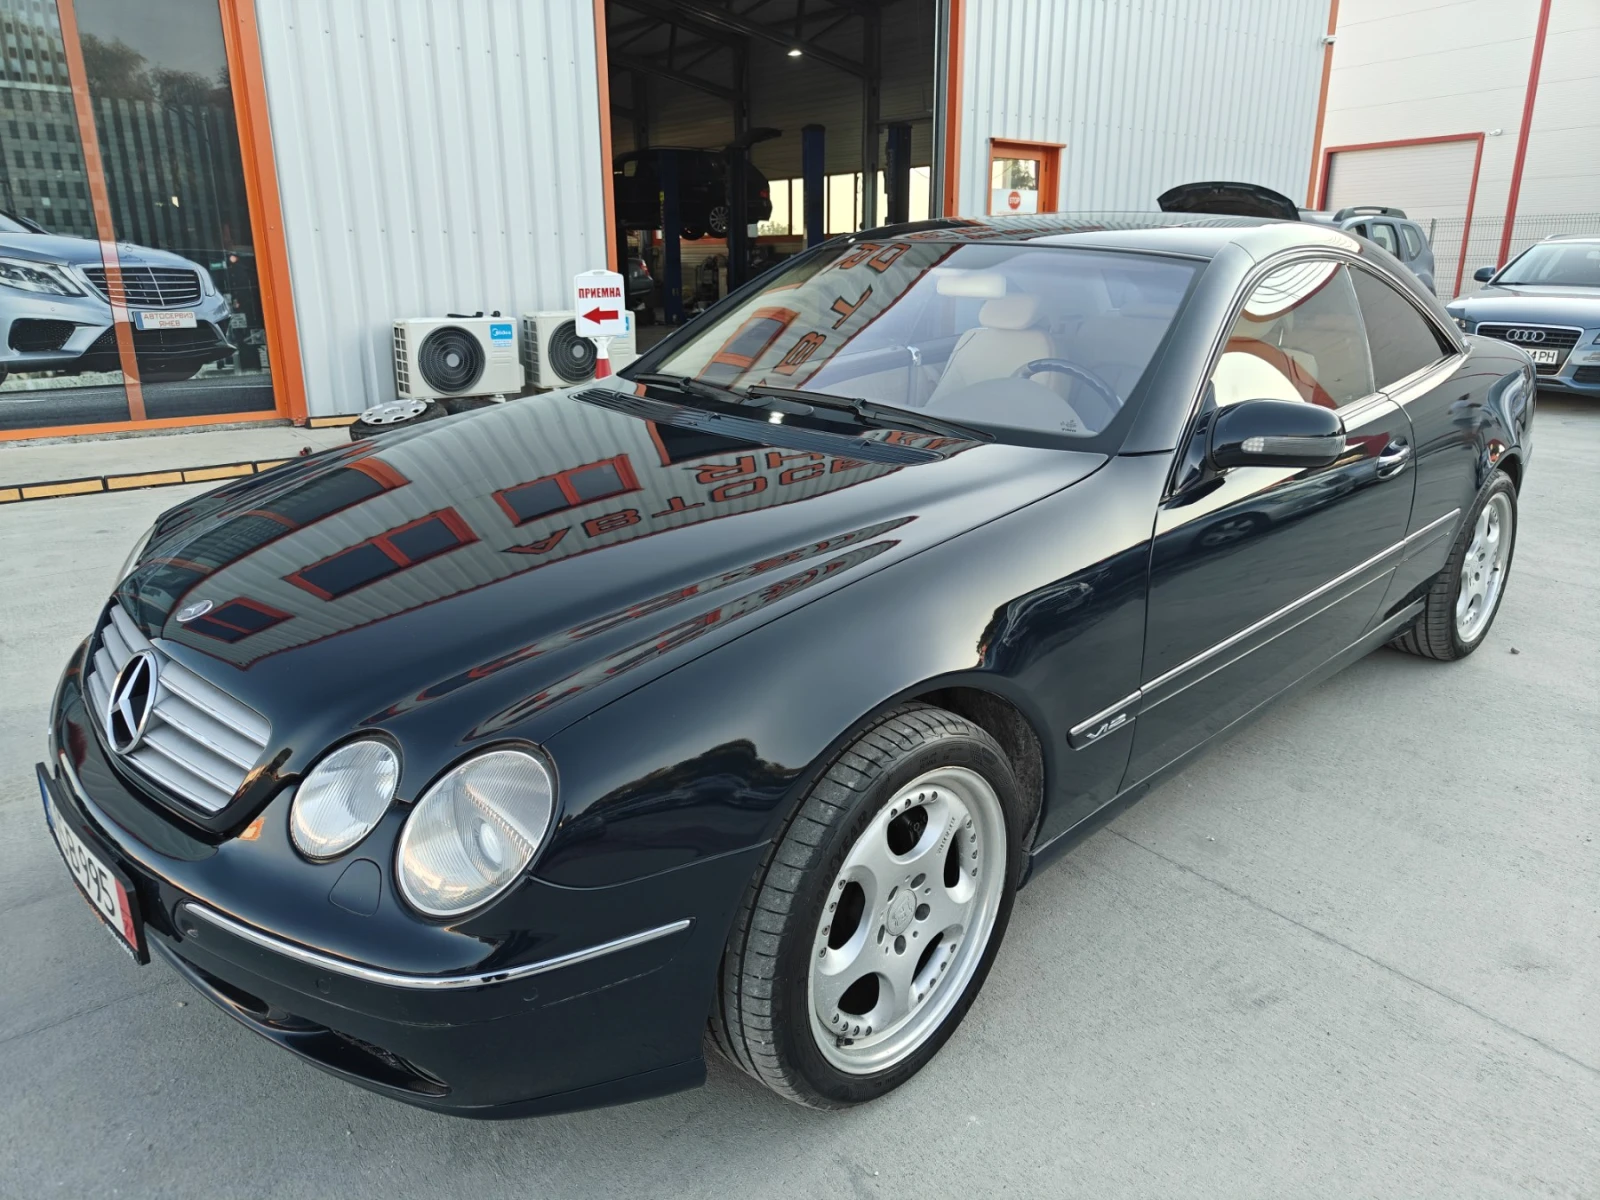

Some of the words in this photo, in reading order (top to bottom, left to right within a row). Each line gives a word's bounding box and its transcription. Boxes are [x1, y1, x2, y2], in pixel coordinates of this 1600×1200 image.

[578, 287, 621, 299] ПРИЕМНА
[143, 312, 193, 320] АВТОСЕРВИЗ
[1538, 351, 1556, 362] PH
[1086, 713, 1127, 739] V12
